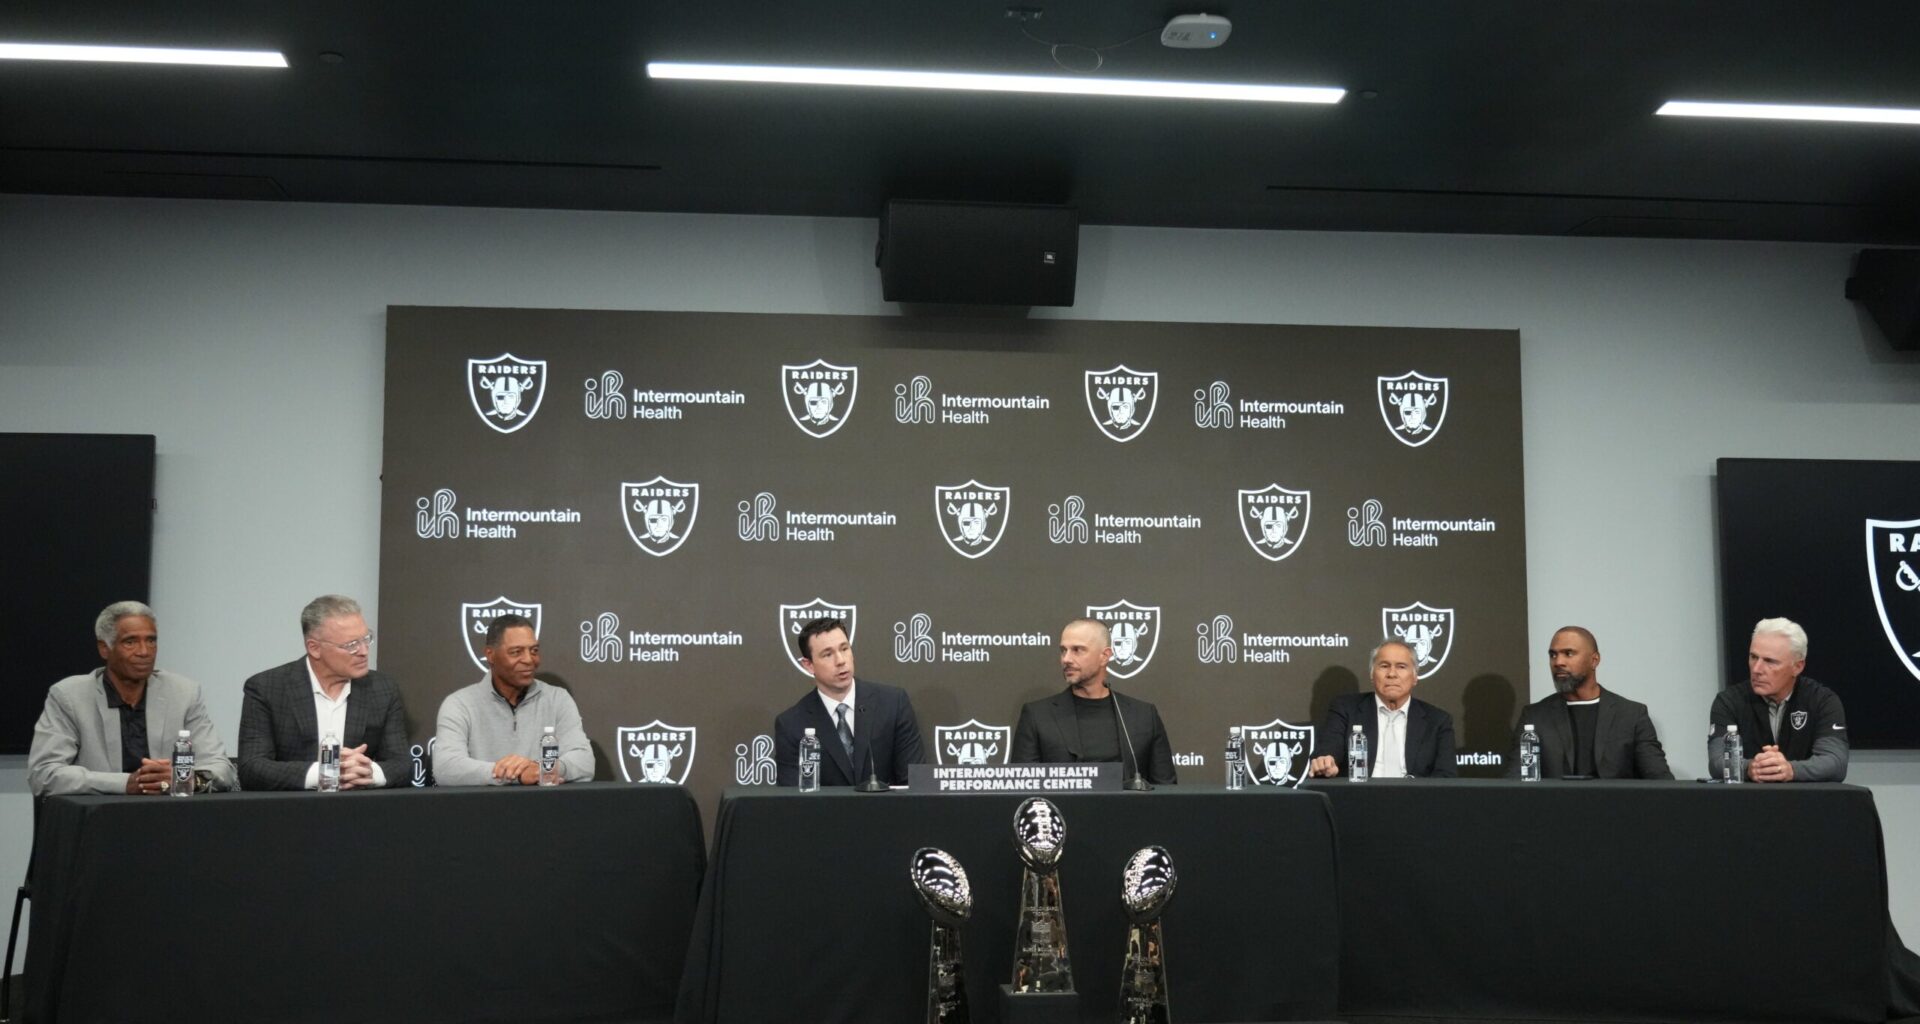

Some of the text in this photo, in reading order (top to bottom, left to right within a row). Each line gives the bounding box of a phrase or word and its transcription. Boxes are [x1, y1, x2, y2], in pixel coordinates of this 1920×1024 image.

[479, 365, 536, 374] RAIDERS
[792, 371, 847, 380] RAIDERS
[1095, 377, 1148, 385] RAIDERS
[1387, 382, 1439, 391] RAIDERS
[634, 389, 744, 403] Intermountain
[943, 394, 1049, 408] Intermountain
[634, 406, 682, 419] Health
[1241, 399, 1343, 414] Intermountain
[943, 410, 989, 423] Health
[1241, 415, 1285, 428] Health
[632, 488, 689, 497] RAIDERS
[945, 492, 1000, 500] RAIDERS
[1248, 495, 1301, 504] RAIDERS
[467, 508, 580, 522] Intermountain
[787, 511, 896, 525] Intermountain
[1095, 514, 1200, 528] Intermountain
[1393, 517, 1495, 531] Intermountain
[467, 525, 516, 538] Health
[787, 528, 834, 540] Health
[1096, 530, 1141, 543] Health
[1393, 533, 1437, 546] Health
[790, 610, 846, 619] RAIDERS
[1097, 612, 1151, 620] RAIDERS
[1392, 614, 1444, 622] RAIDERS
[630, 631, 742, 645] Intermountain
[942, 632, 1050, 645] Intermountain
[1244, 633, 1348, 646] Intermountain
[630, 648, 678, 661] Health
[943, 648, 989, 661] Health
[1244, 649, 1289, 662] Health
[628, 733, 685, 741] RAIDERS
[945, 732, 1001, 740] RAIDERS
[1251, 731, 1305, 739] RAIDERS
[934, 767, 1098, 778] INTERMOUNTAIN HEALTH
[940, 779, 1092, 790] PERFORMANCE CENTER
